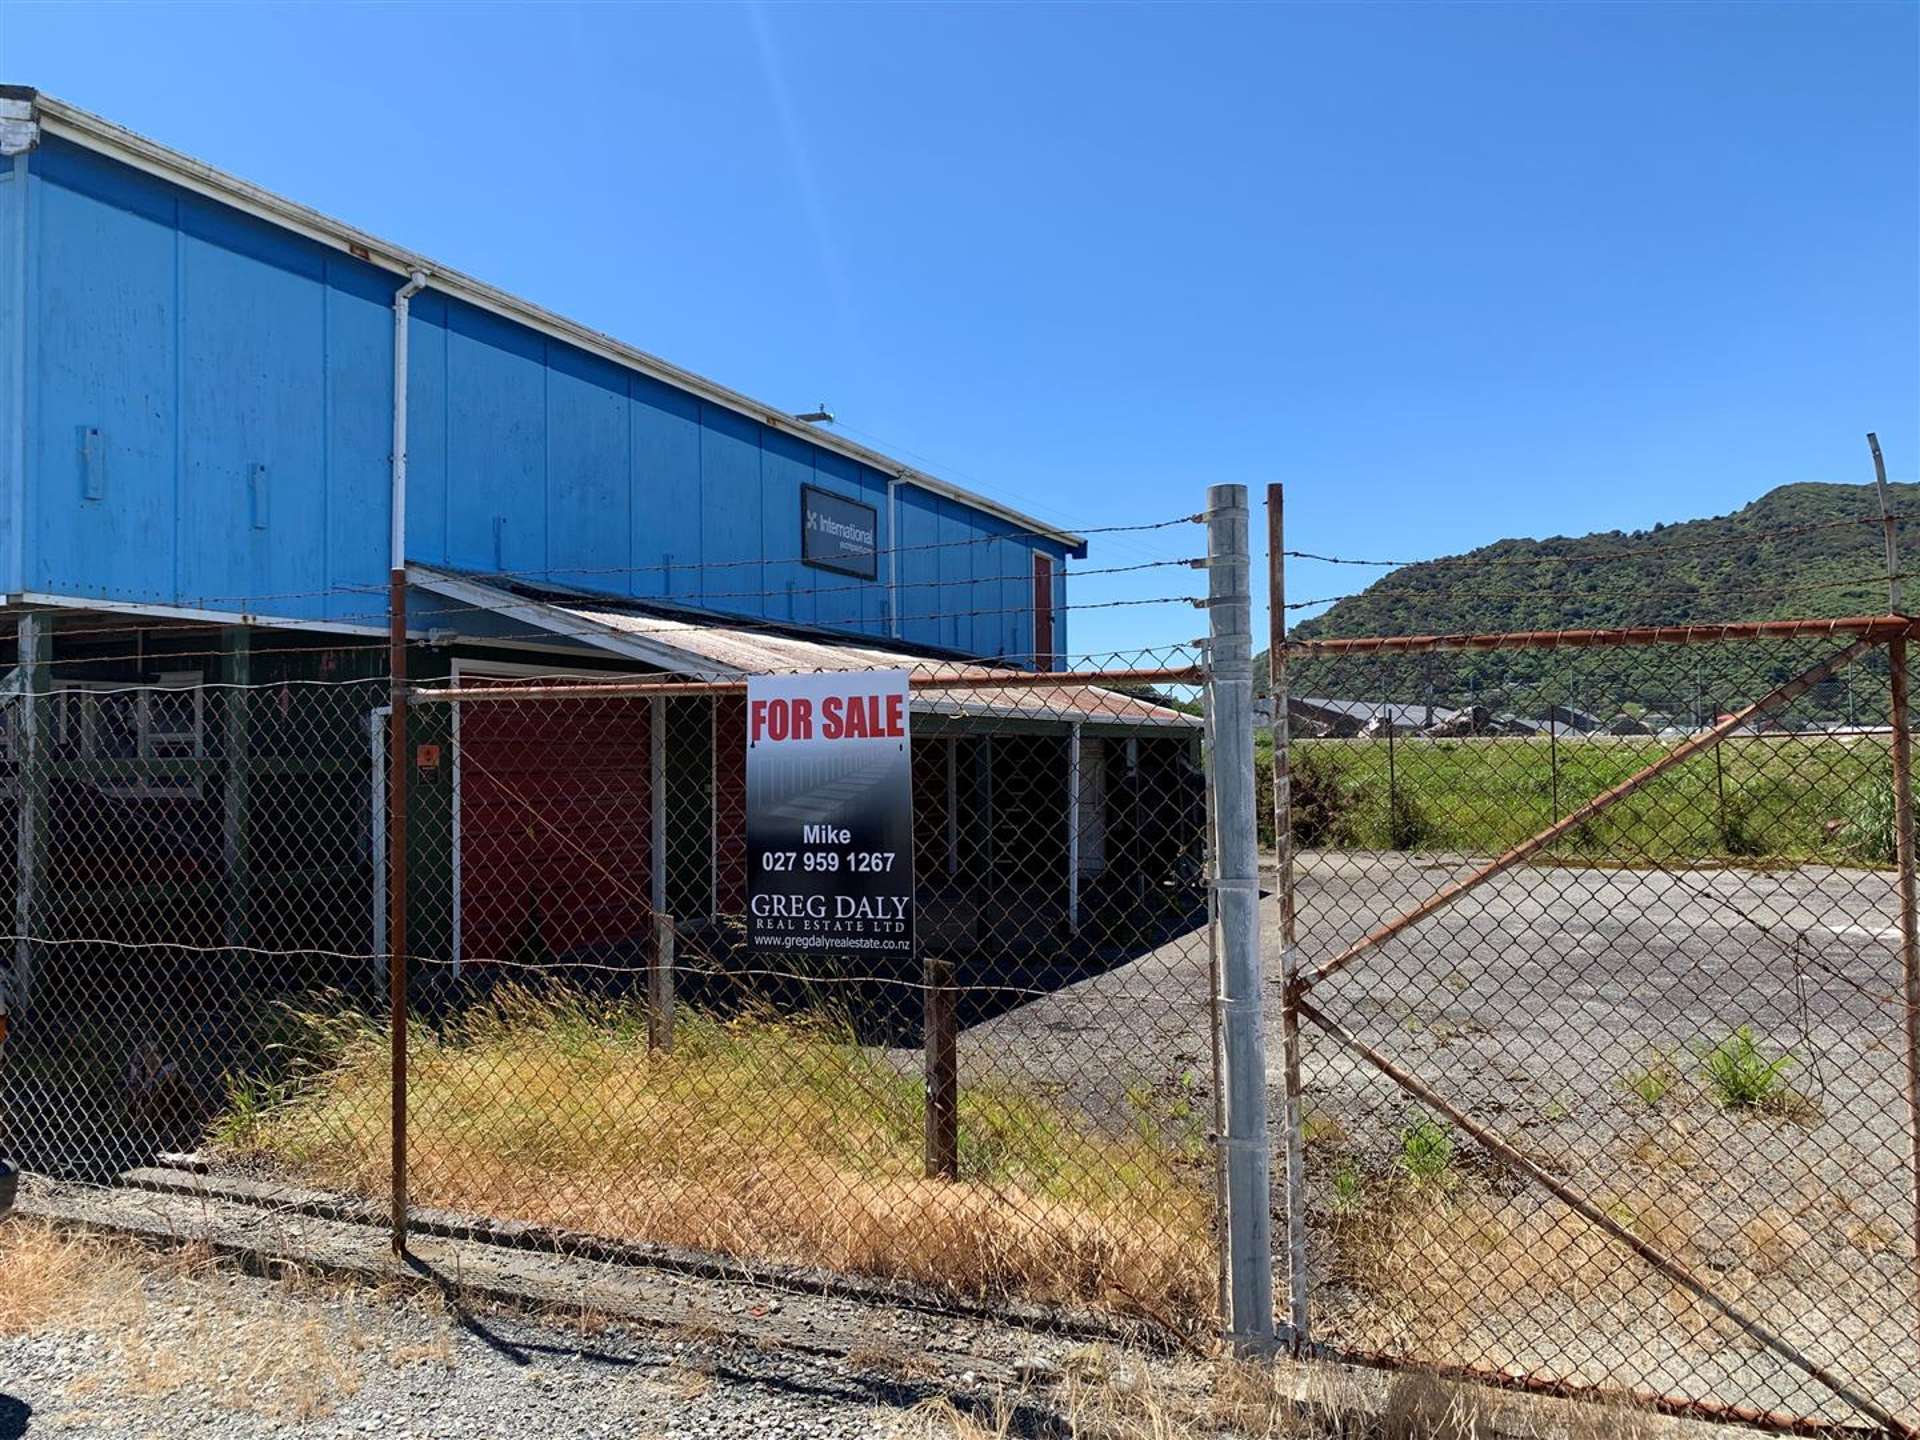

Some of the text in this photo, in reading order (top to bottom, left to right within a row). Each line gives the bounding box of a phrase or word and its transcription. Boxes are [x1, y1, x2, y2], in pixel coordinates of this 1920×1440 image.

[820, 514, 873, 545] International
[751, 694, 905, 742] FOR SALE
[803, 825, 851, 844] Mike
[762, 852, 895, 872] 027 959 1267
[751, 894, 909, 920] GREG DALY
[756, 919, 905, 933] REAL ESTATE LTD
[754, 934, 910, 950] www.gregdalyrealestate.co.nz
